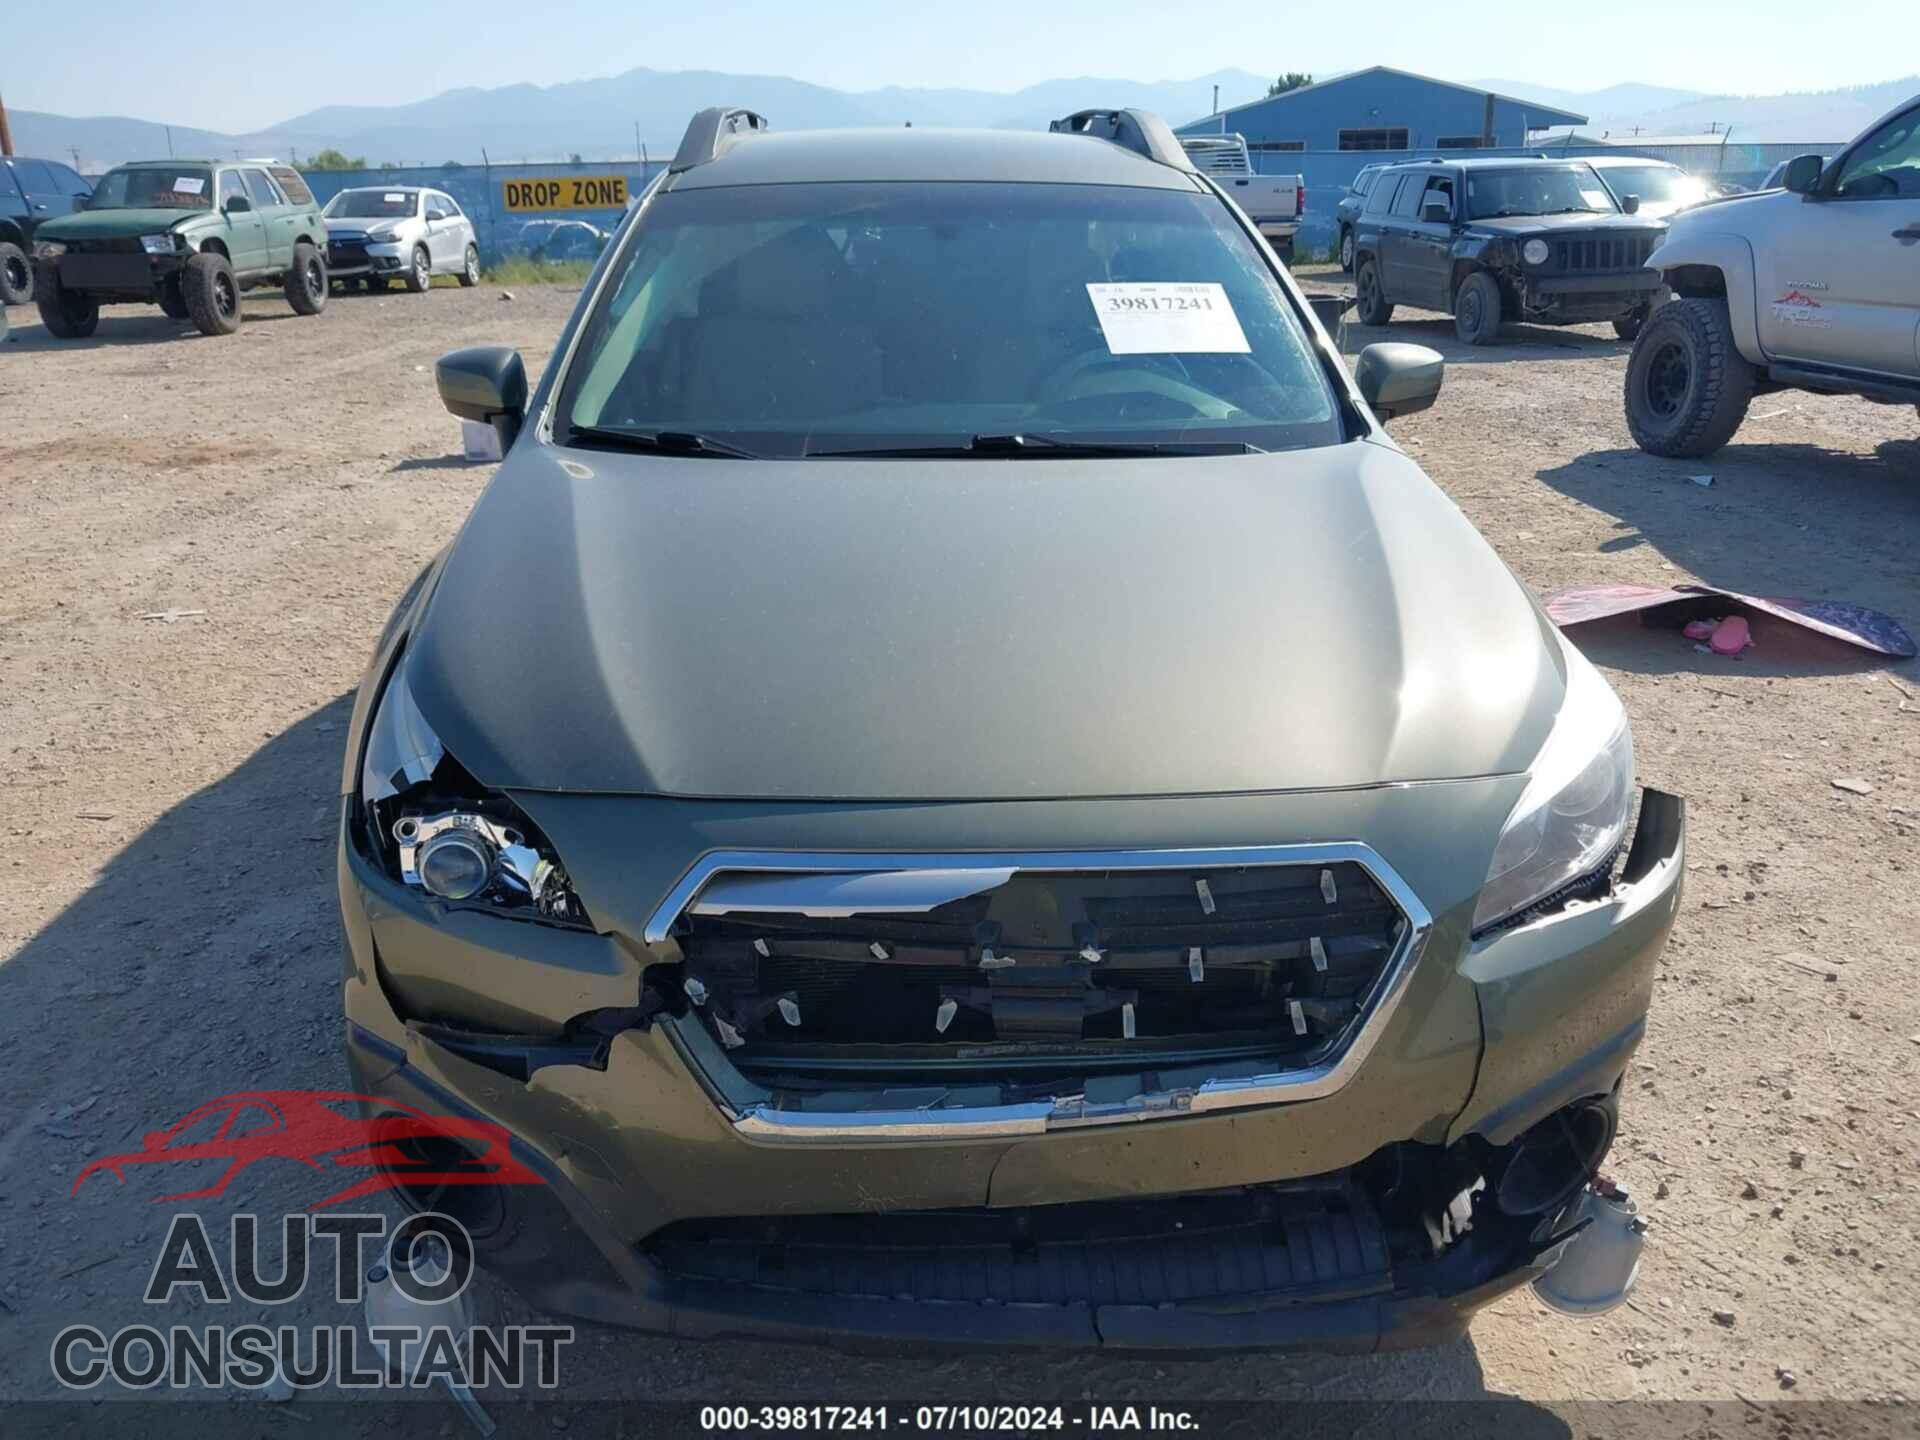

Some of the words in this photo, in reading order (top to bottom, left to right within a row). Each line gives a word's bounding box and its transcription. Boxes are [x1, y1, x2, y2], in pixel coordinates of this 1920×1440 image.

[506, 182, 561, 207] DROP
[572, 179, 625, 205] ZONE
[1107, 297, 1214, 312] 39817241
